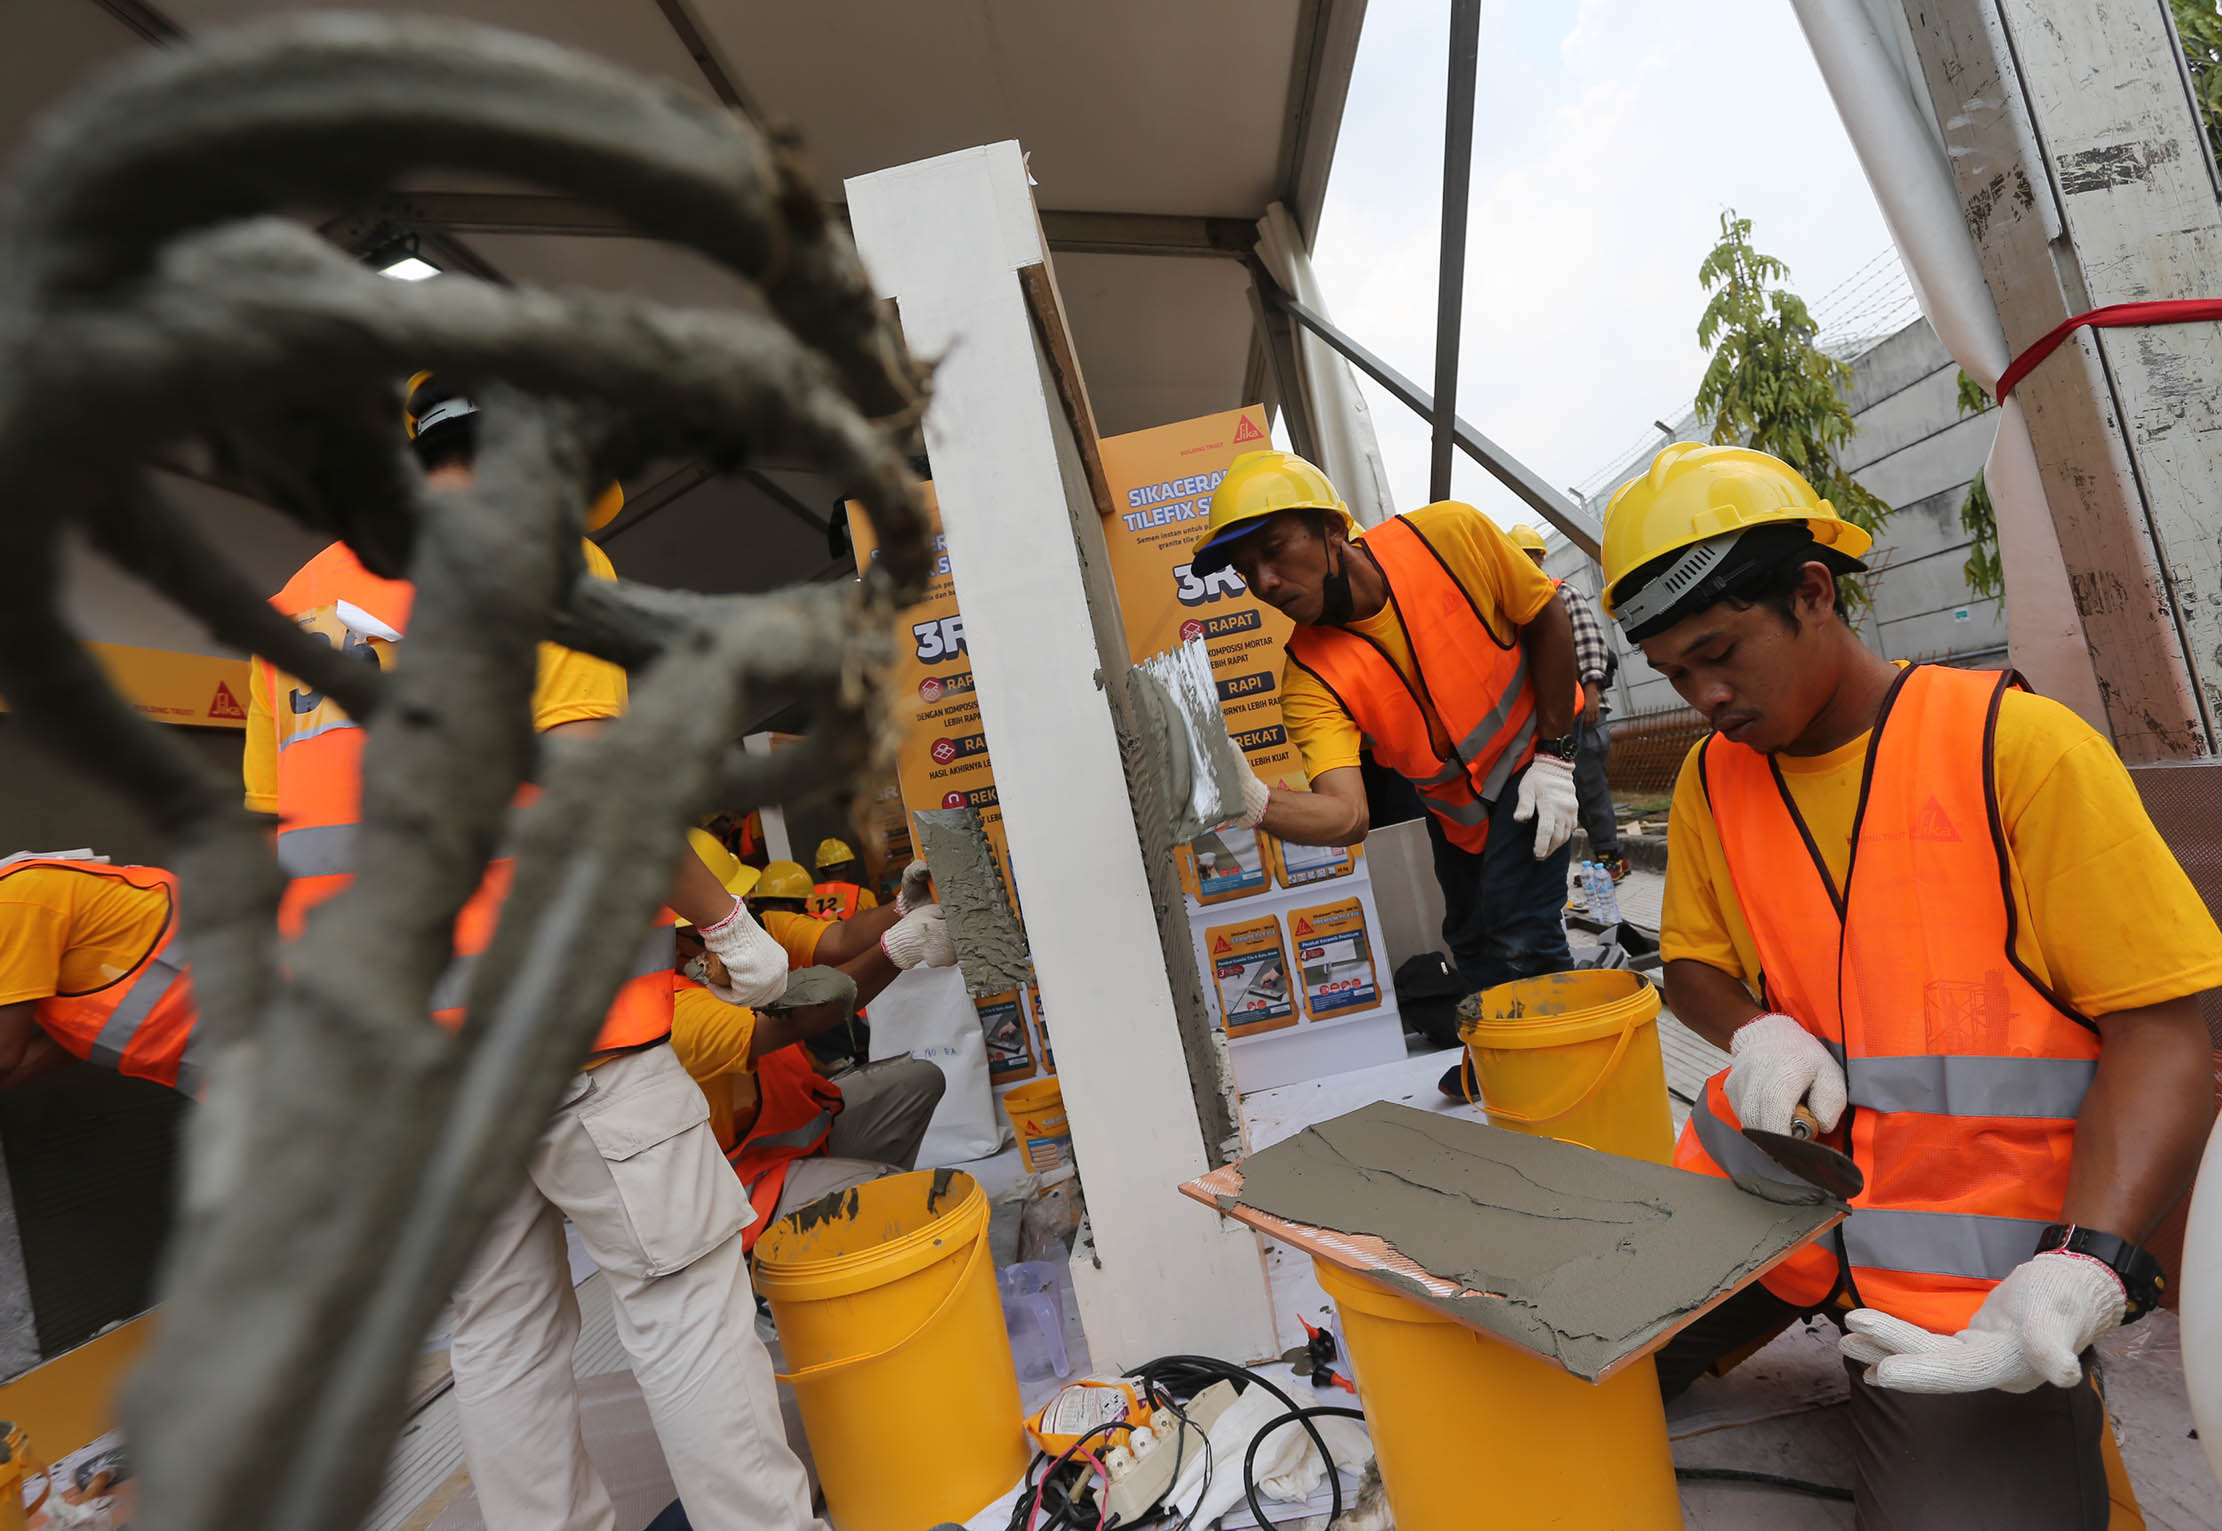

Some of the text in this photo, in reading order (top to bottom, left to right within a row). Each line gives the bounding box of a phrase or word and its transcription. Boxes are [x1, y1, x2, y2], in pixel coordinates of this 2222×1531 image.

[1122, 496, 1211, 531] TILEFIX S
[1208, 612, 1254, 633] RAPAT
[1245, 636, 1273, 650] MORTAR
[1209, 654, 1248, 670] EBIH RAPAT
[1228, 676, 1262, 694] RAPI
[1247, 699, 1267, 711] LEBIH
[916, 708, 944, 722] DENGAN
[944, 716, 963, 727] LEBIH
[1234, 728, 1279, 748] REKAT
[1251, 751, 1289, 767] LEBIH KUAT
[929, 768, 948, 779] HASIL
[949, 761, 982, 775] AKHIRNYA
[815, 897, 838, 912] 12
